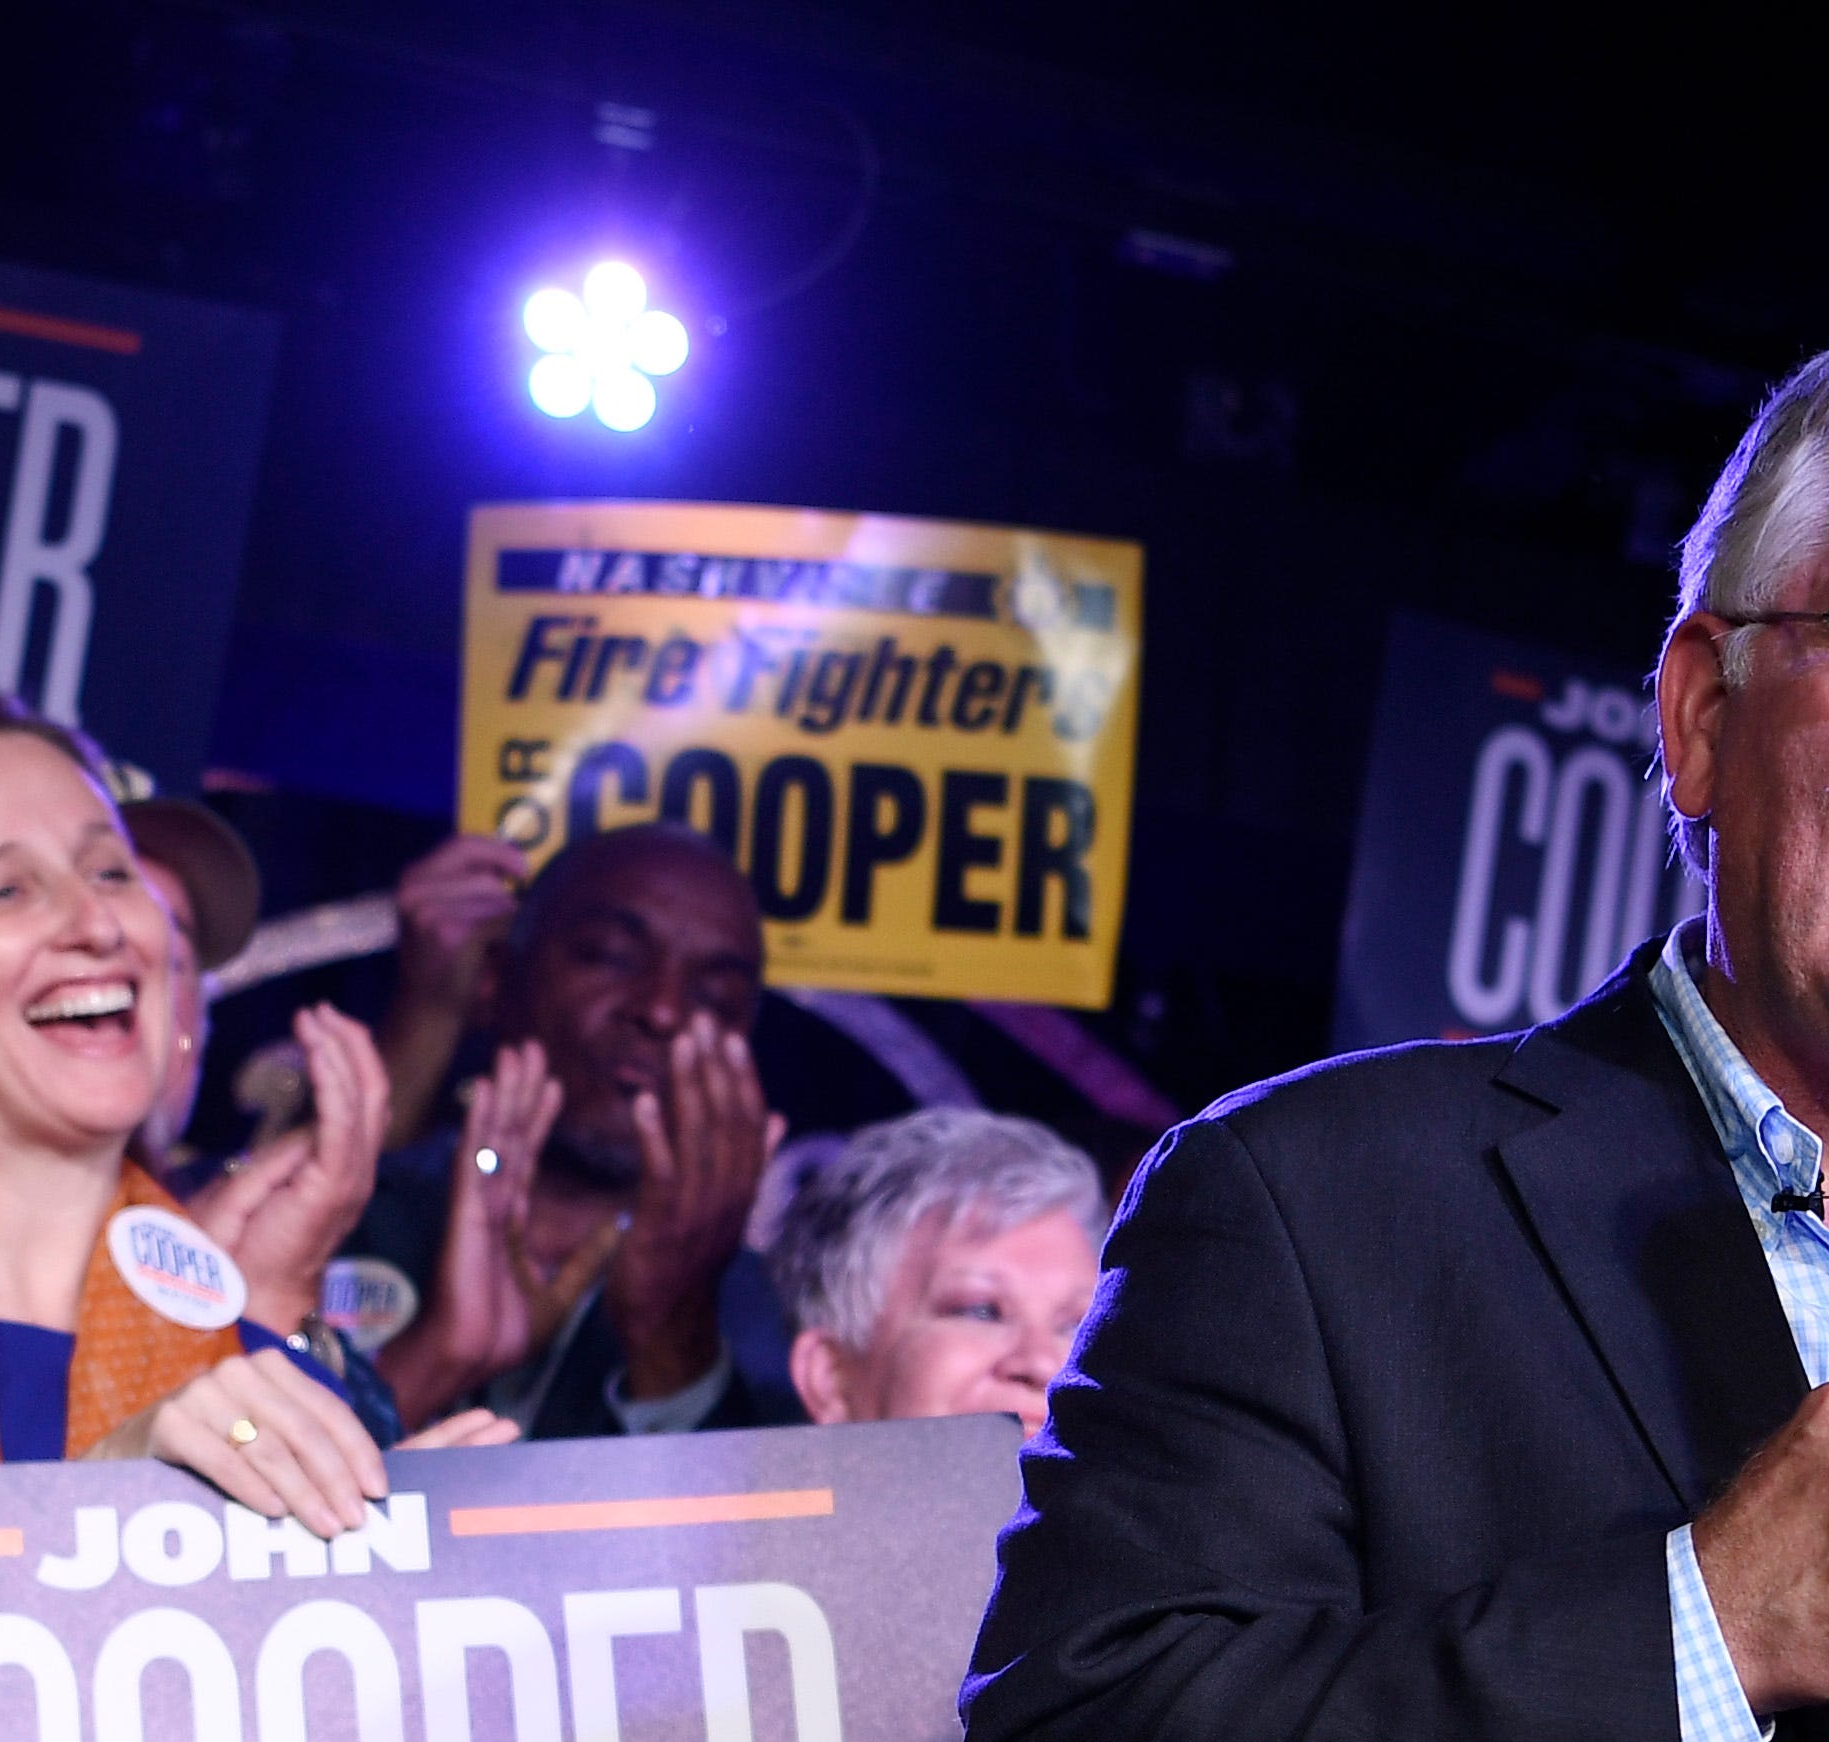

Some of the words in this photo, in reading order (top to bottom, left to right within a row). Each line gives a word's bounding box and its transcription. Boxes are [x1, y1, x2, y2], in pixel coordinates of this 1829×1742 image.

[507, 614, 702, 708] Fire
[496, 738, 551, 852] OR
[129, 1224, 225, 1296] COOPER
[36, 1493, 431, 1591] JOHN
